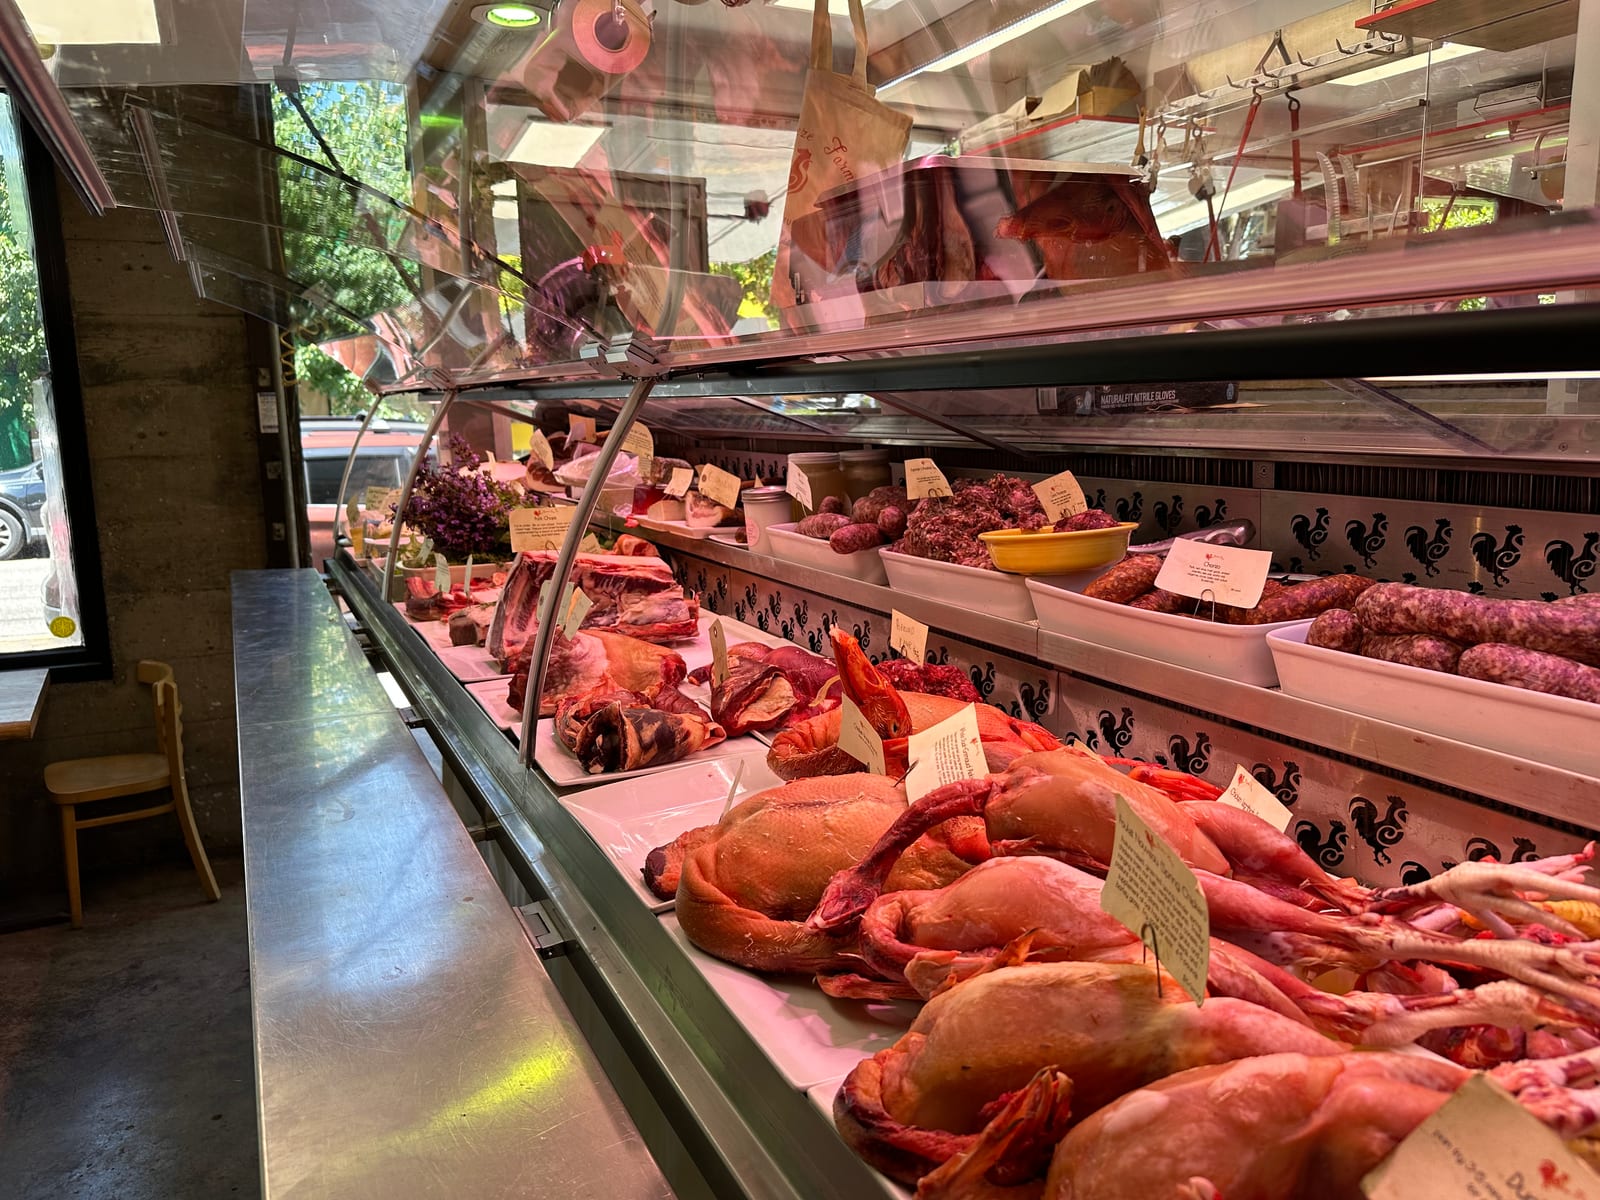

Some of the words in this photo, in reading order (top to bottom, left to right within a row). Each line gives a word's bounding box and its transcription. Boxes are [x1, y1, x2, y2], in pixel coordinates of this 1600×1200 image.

[1100, 395, 1133, 404] NATURALFIT
[1133, 391, 1155, 401] NITRILE
[1155, 390, 1176, 400] GLOVES
